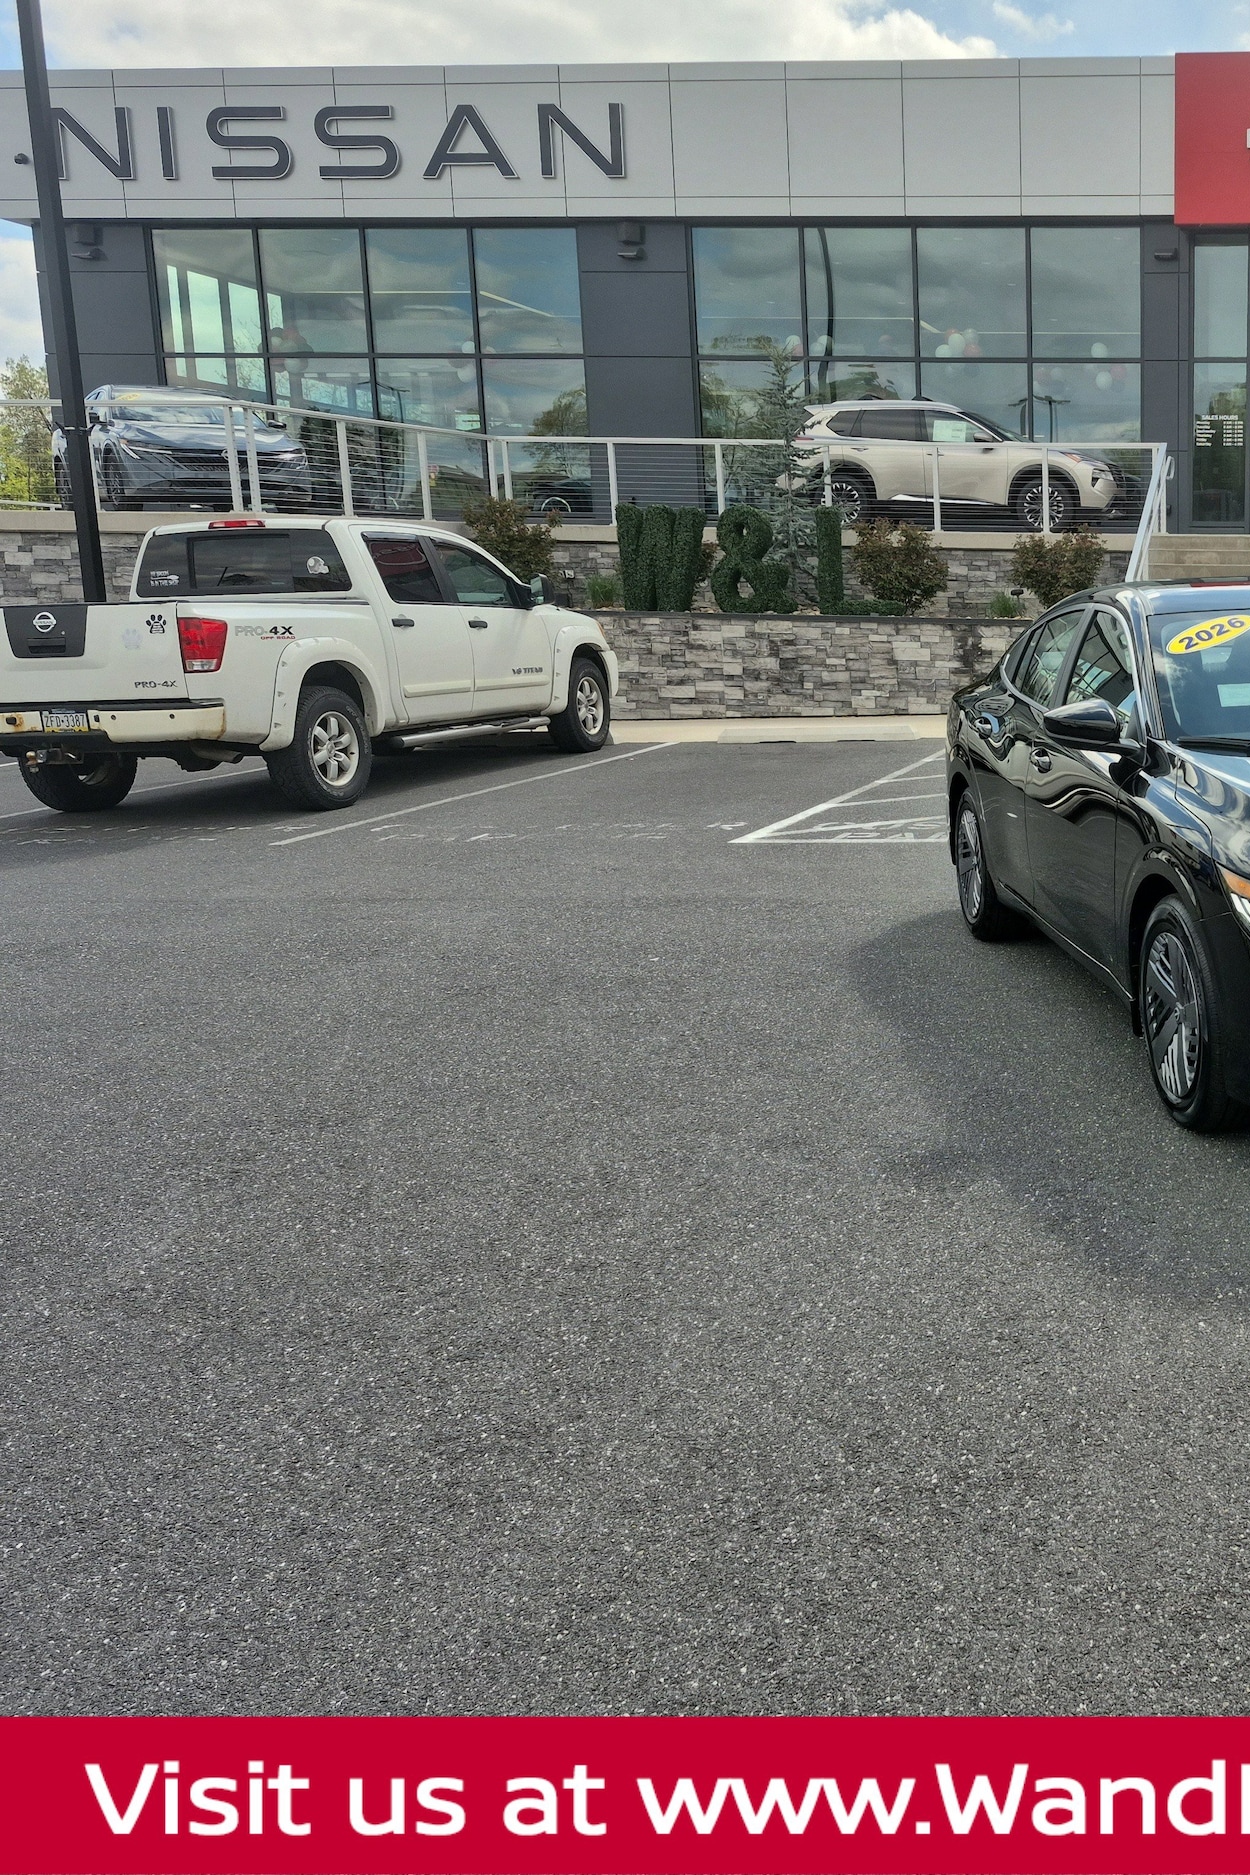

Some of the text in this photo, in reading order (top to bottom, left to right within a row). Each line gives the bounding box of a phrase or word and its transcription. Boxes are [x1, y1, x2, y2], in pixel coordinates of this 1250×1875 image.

[53, 103, 626, 180] NISSAN
[234, 625, 294, 636] PRO-4X
[1178, 617, 1245, 650] 2026
[134, 680, 178, 689] PRO-4X
